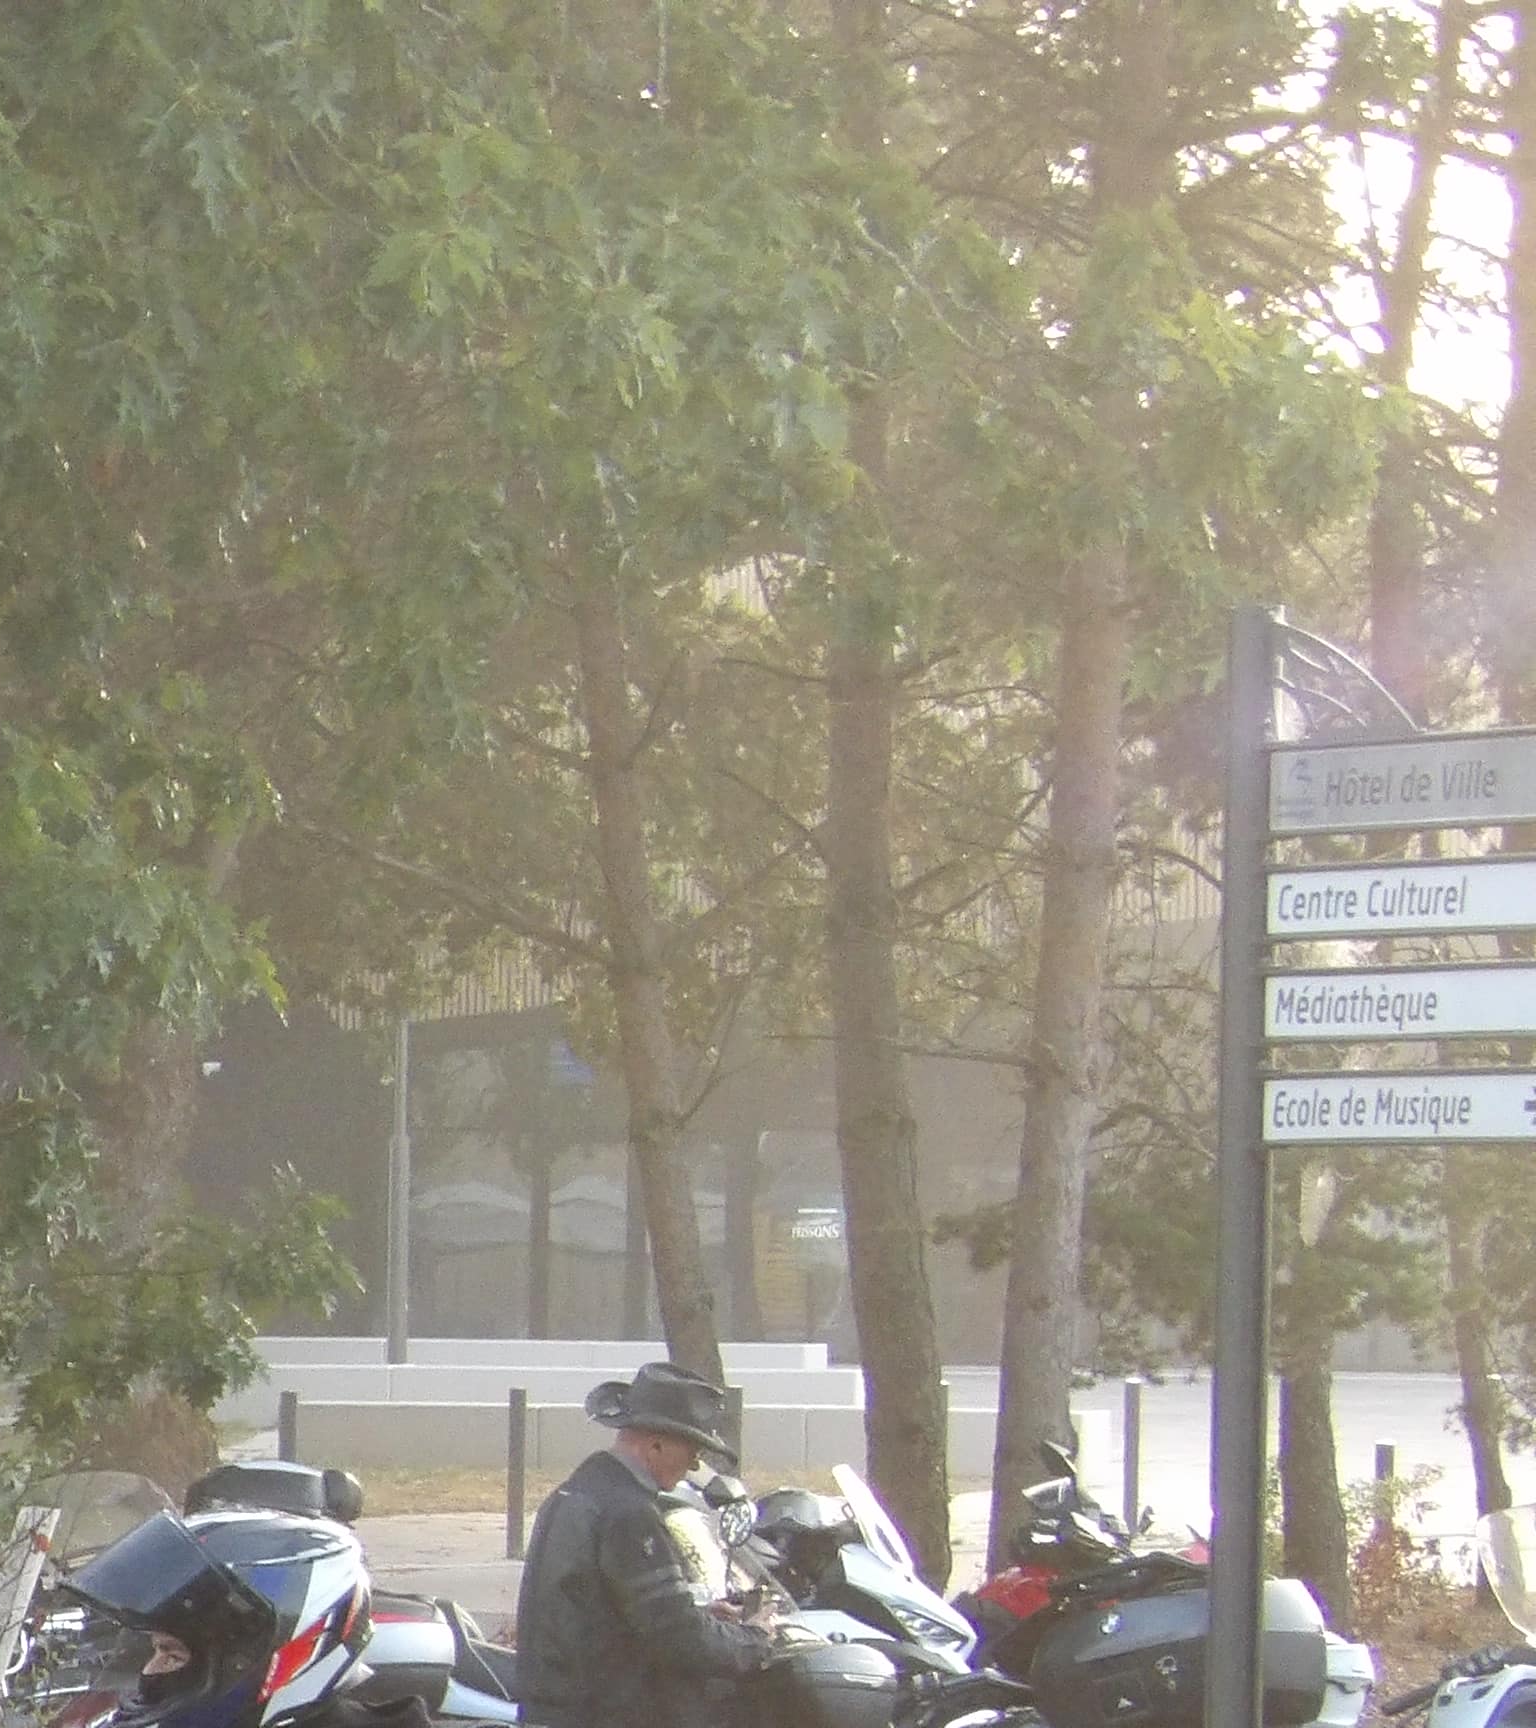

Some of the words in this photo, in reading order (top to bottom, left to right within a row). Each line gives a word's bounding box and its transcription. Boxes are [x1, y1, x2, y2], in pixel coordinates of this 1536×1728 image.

[1324, 766, 1394, 807] Hôtel
[1401, 764, 1432, 802] de
[1442, 760, 1498, 801] Ville
[1278, 884, 1358, 921] Centre
[1367, 875, 1468, 917] Culturel
[1274, 985, 1438, 1031] Médiathèque
[1272, 1087, 1330, 1128] Ecole
[1339, 1086, 1367, 1126] de
[1374, 1086, 1472, 1134] Musique
